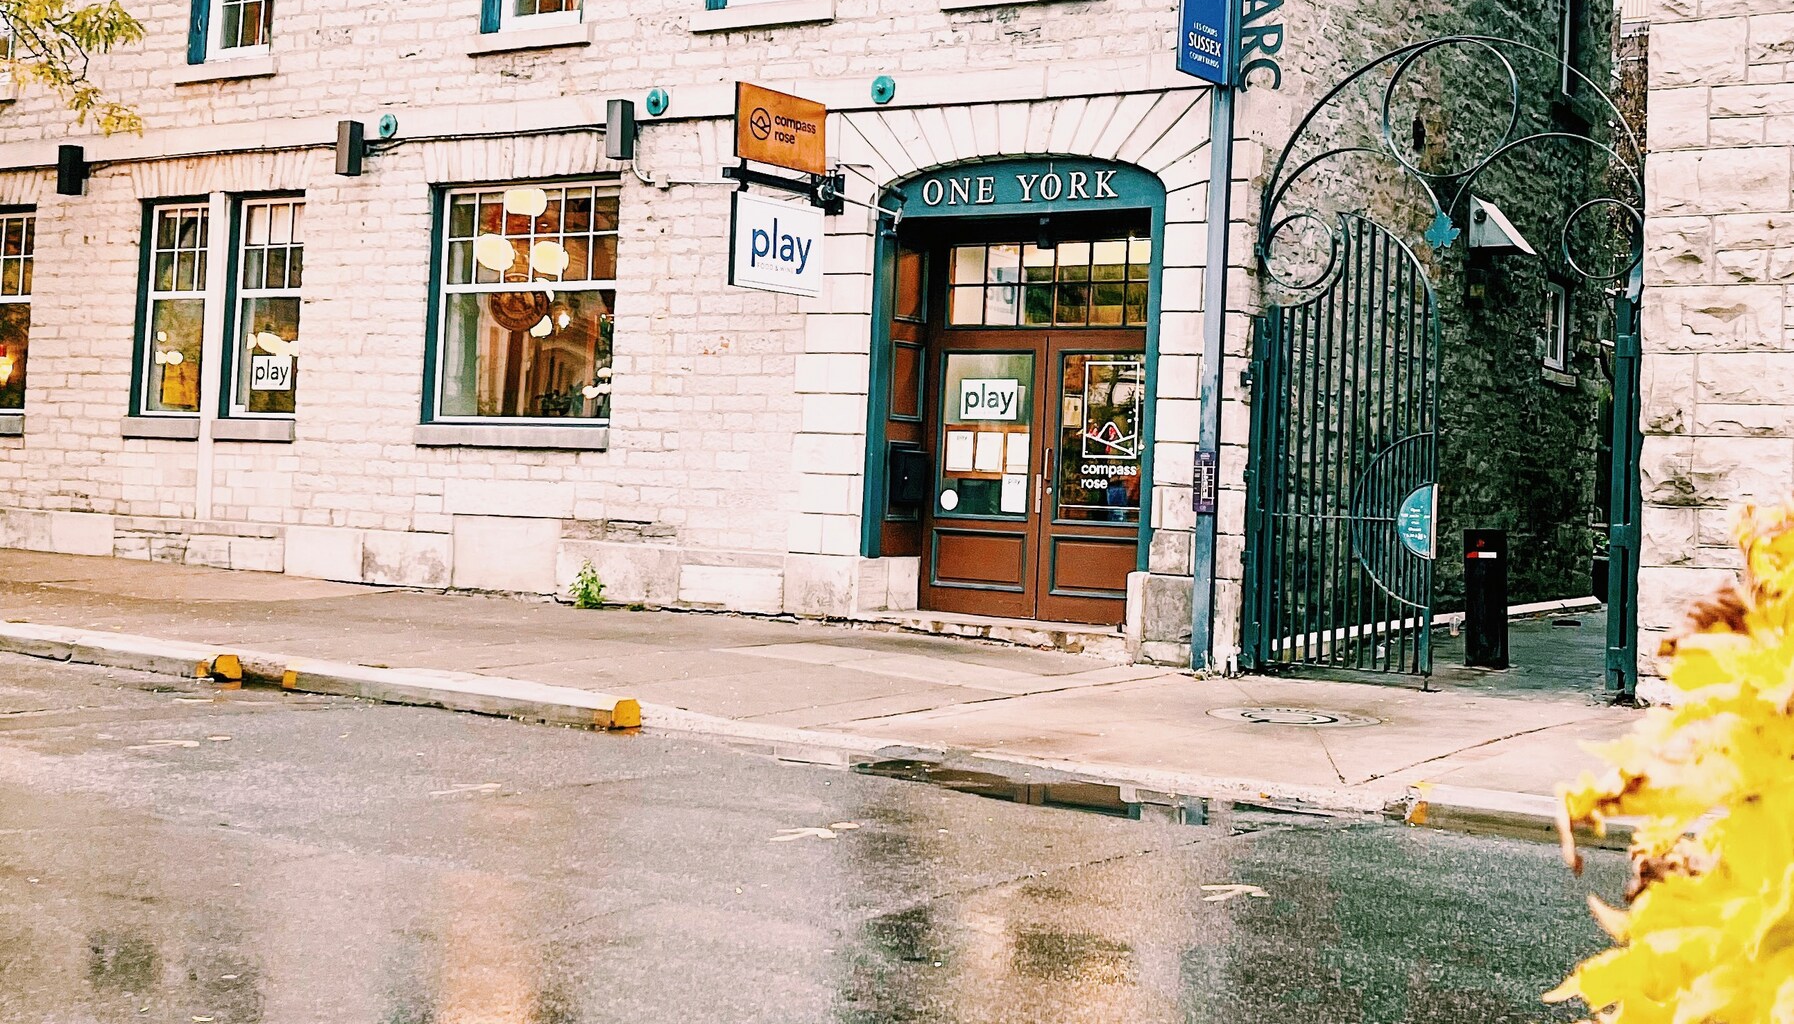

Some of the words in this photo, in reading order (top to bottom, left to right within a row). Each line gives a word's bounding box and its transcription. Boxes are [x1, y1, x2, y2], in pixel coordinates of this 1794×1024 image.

[1188, 31, 1221, 58] SUSSEX
[774, 114, 816, 135] compass
[774, 131, 796, 145] rose
[922, 176, 996, 206] ONE
[1016, 170, 1119, 202] YORK
[750, 217, 812, 275] play
[255, 359, 289, 386] play
[964, 383, 1014, 415] play
[1081, 462, 1137, 478] compass
[1081, 477, 1108, 490] rose
